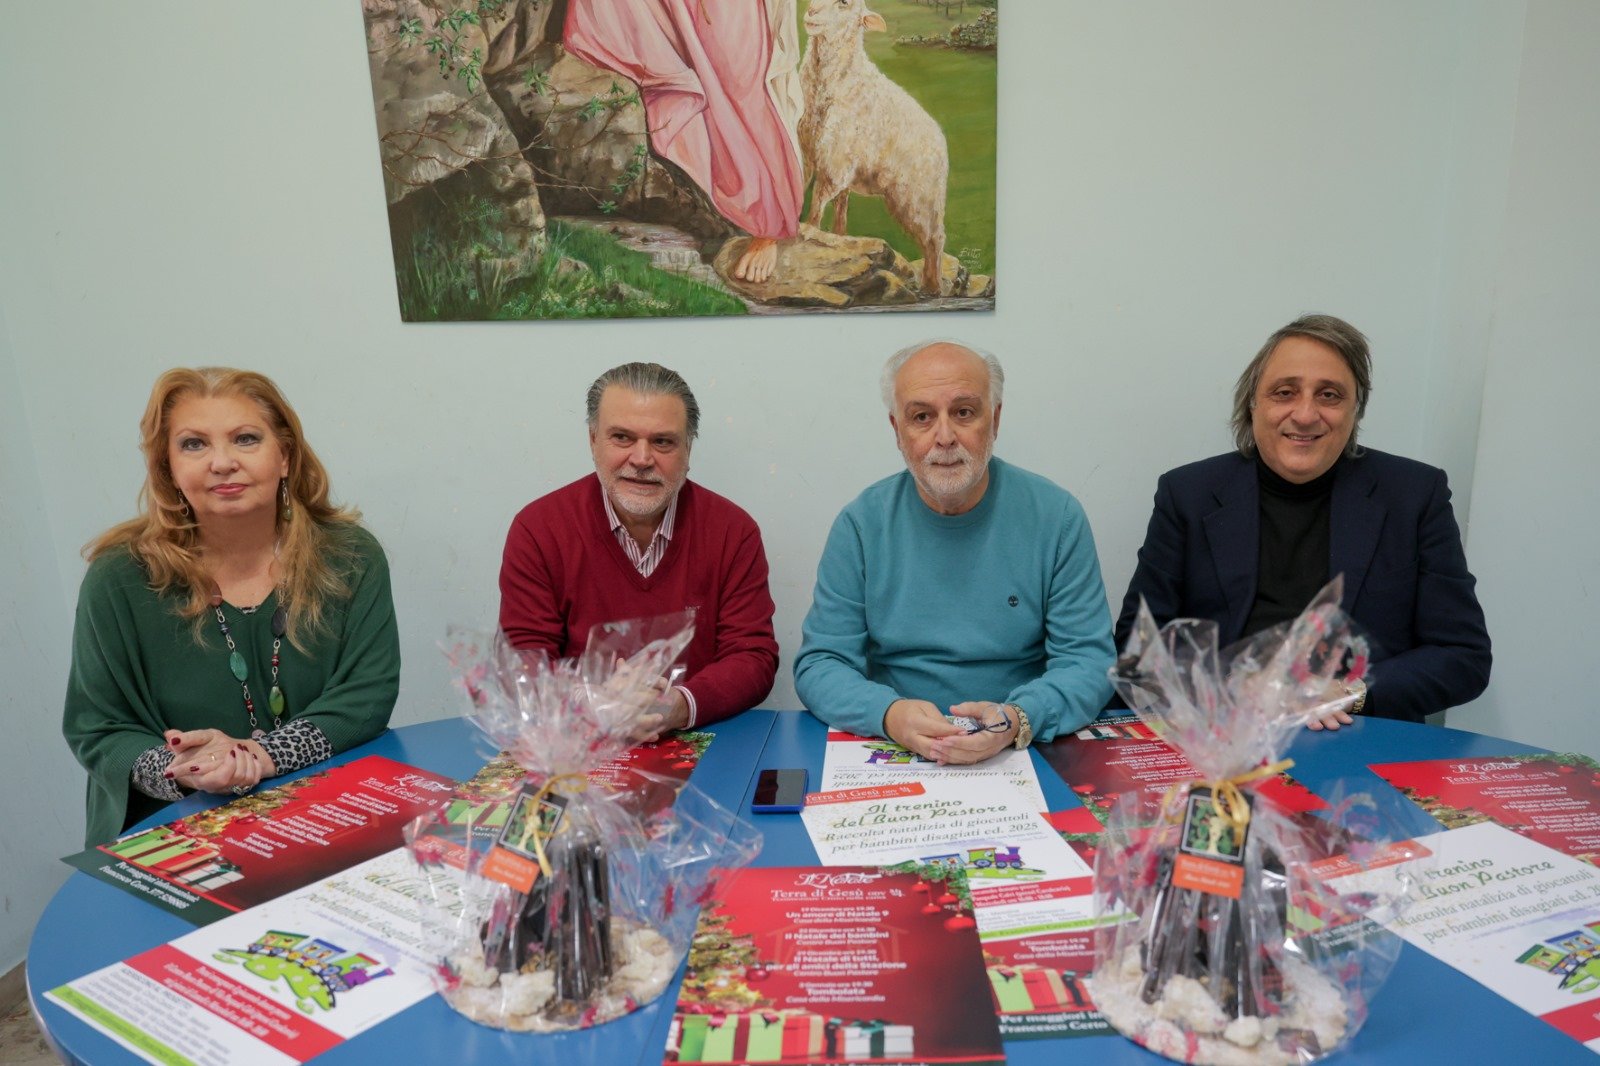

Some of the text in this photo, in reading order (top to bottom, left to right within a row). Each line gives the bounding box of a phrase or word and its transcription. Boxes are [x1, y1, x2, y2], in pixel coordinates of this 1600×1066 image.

[1441, 775, 1477, 783] Terra
[836, 791, 847, 799] di
[849, 789, 879, 798] Gesù
[864, 800, 962, 816] Il trenino
[832, 805, 1008, 829] del Buon Pastore
[825, 812, 1030, 841] Raccolta natalizia di giocattoli
[831, 842, 857, 854] per
[859, 835, 918, 849] bambini
[921, 829, 980, 842] disagiati
[984, 827, 1004, 835] ed.
[1009, 822, 1039, 832] 2025
[1423, 859, 1494, 880] trenino
[820, 872, 882, 886] Natale
[1419, 860, 1555, 900] Buon Pastore
[771, 889, 807, 898] Terra
[811, 888, 823, 897] di
[828, 888, 863, 898] Gesù
[1394, 870, 1594, 928] Raccolta natalizia di giocattoli
[1423, 929, 1449, 945] per
[1448, 911, 1509, 934] bambini
[1509, 897, 1569, 919] disagiati
[1568, 890, 1592, 905] ed.
[802, 955, 838, 963] Natale
[765, 961, 907, 972] per gli amici della Stazione
[806, 988, 865, 996] Tombolata
[1000, 1011, 1087, 1023] Per maggiori
[999, 1020, 1108, 1033] Francesco Certo
